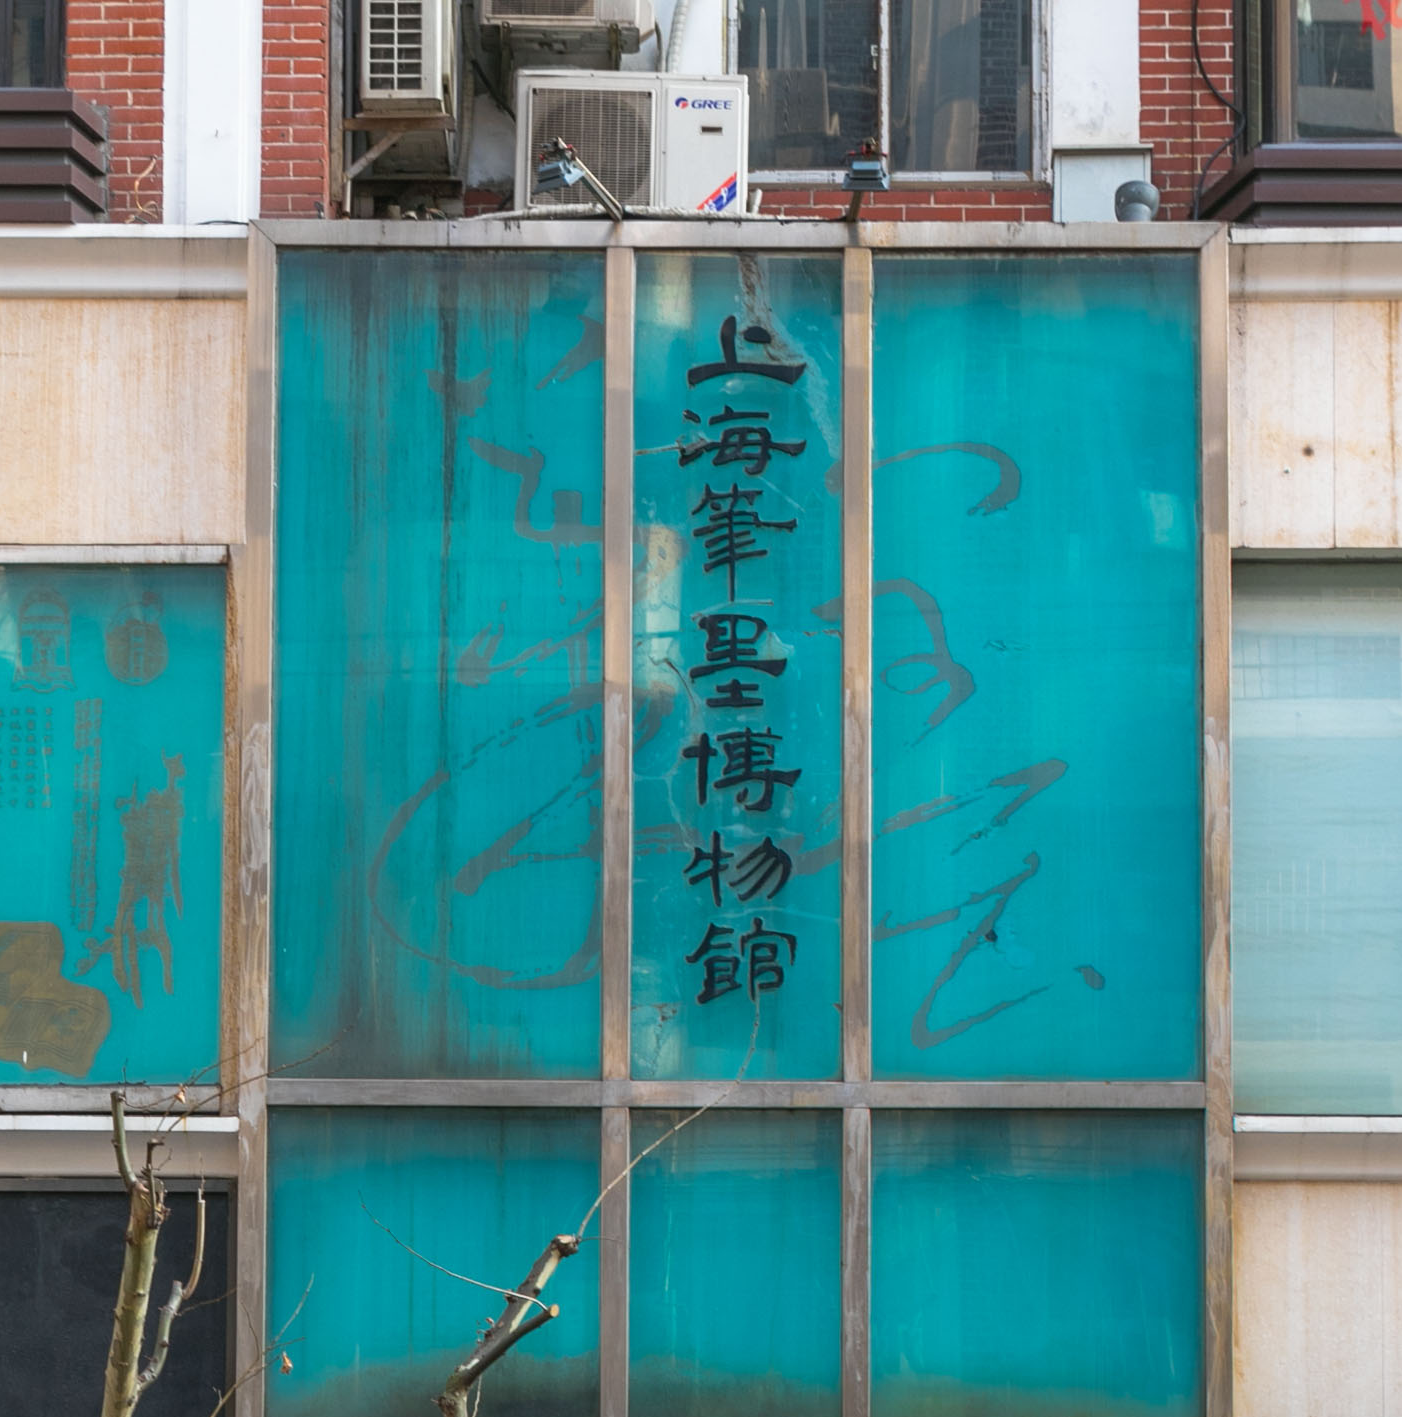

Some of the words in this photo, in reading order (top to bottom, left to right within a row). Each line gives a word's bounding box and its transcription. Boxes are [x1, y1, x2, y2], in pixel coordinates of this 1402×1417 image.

[691, 99, 734, 110] GREE
[677, 314, 808, 1006] 上海筆墨博物館
